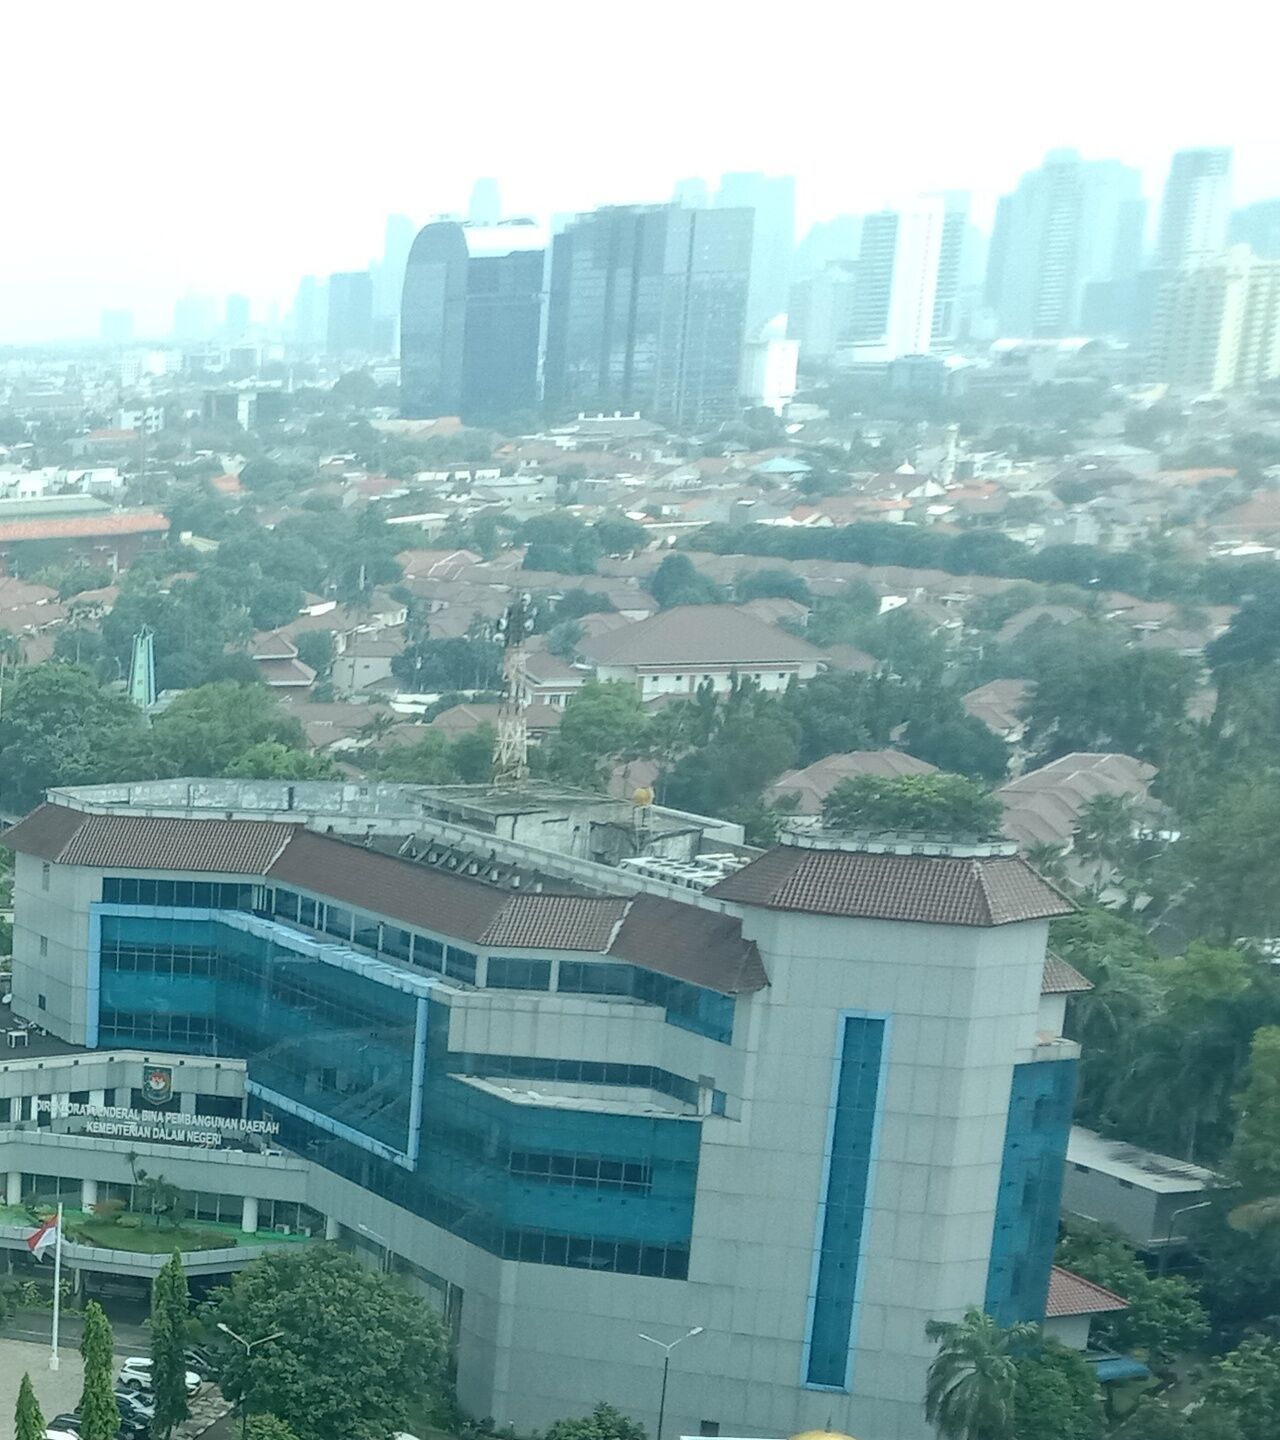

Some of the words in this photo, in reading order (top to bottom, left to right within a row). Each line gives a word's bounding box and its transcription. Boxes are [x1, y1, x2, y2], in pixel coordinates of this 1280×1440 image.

[37, 1100, 91, 1116] DIRKTORAT
[142, 1109, 164, 1123] BINA
[165, 1111, 239, 1131] PEMBANGUNAN
[240, 1118, 279, 1134] DAERAH
[86, 1121, 151, 1138] KEMENTERIAN
[152, 1127, 185, 1142] DALAM
[186, 1130, 222, 1145] NEGERI
